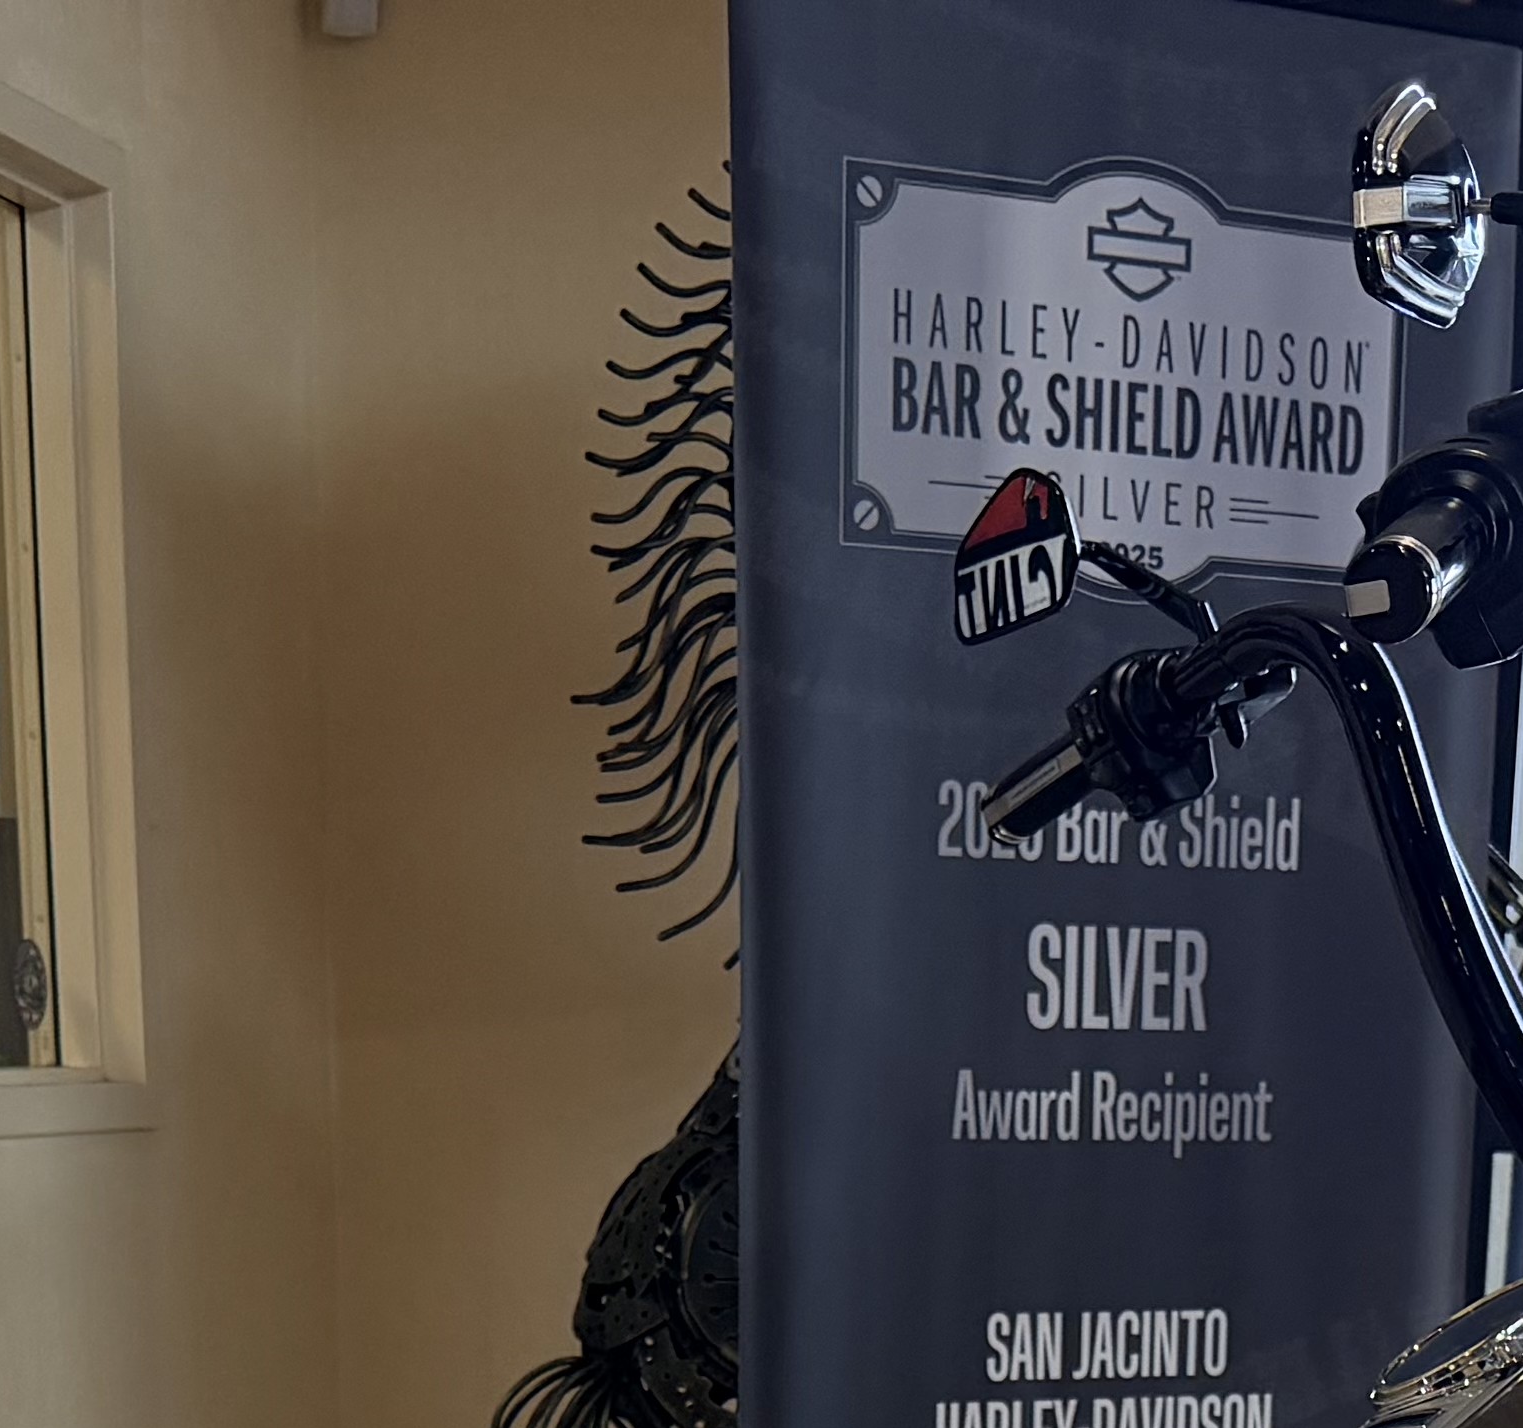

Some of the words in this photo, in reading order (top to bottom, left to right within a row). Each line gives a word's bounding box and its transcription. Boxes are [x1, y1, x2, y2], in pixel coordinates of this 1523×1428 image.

[891, 289, 1363, 394] HARLEY-DAVIDSON
[891, 356, 981, 441] BAR
[998, 368, 1031, 446] &
[1045, 374, 1199, 461] SHIELD
[1213, 392, 1365, 477] AWARD
[937, 779, 1044, 862] 20
[1056, 801, 1128, 864] Bar
[1139, 818, 1169, 867] &
[1178, 793, 1302, 872] Shield
[1026, 923, 1209, 1032] SILVER
[951, 1068, 1081, 1142] Award
[1092, 1069, 1274, 1158] Recipient
[986, 1312, 1063, 1382] SAN
[1072, 1308, 1229, 1381] JACINTO
